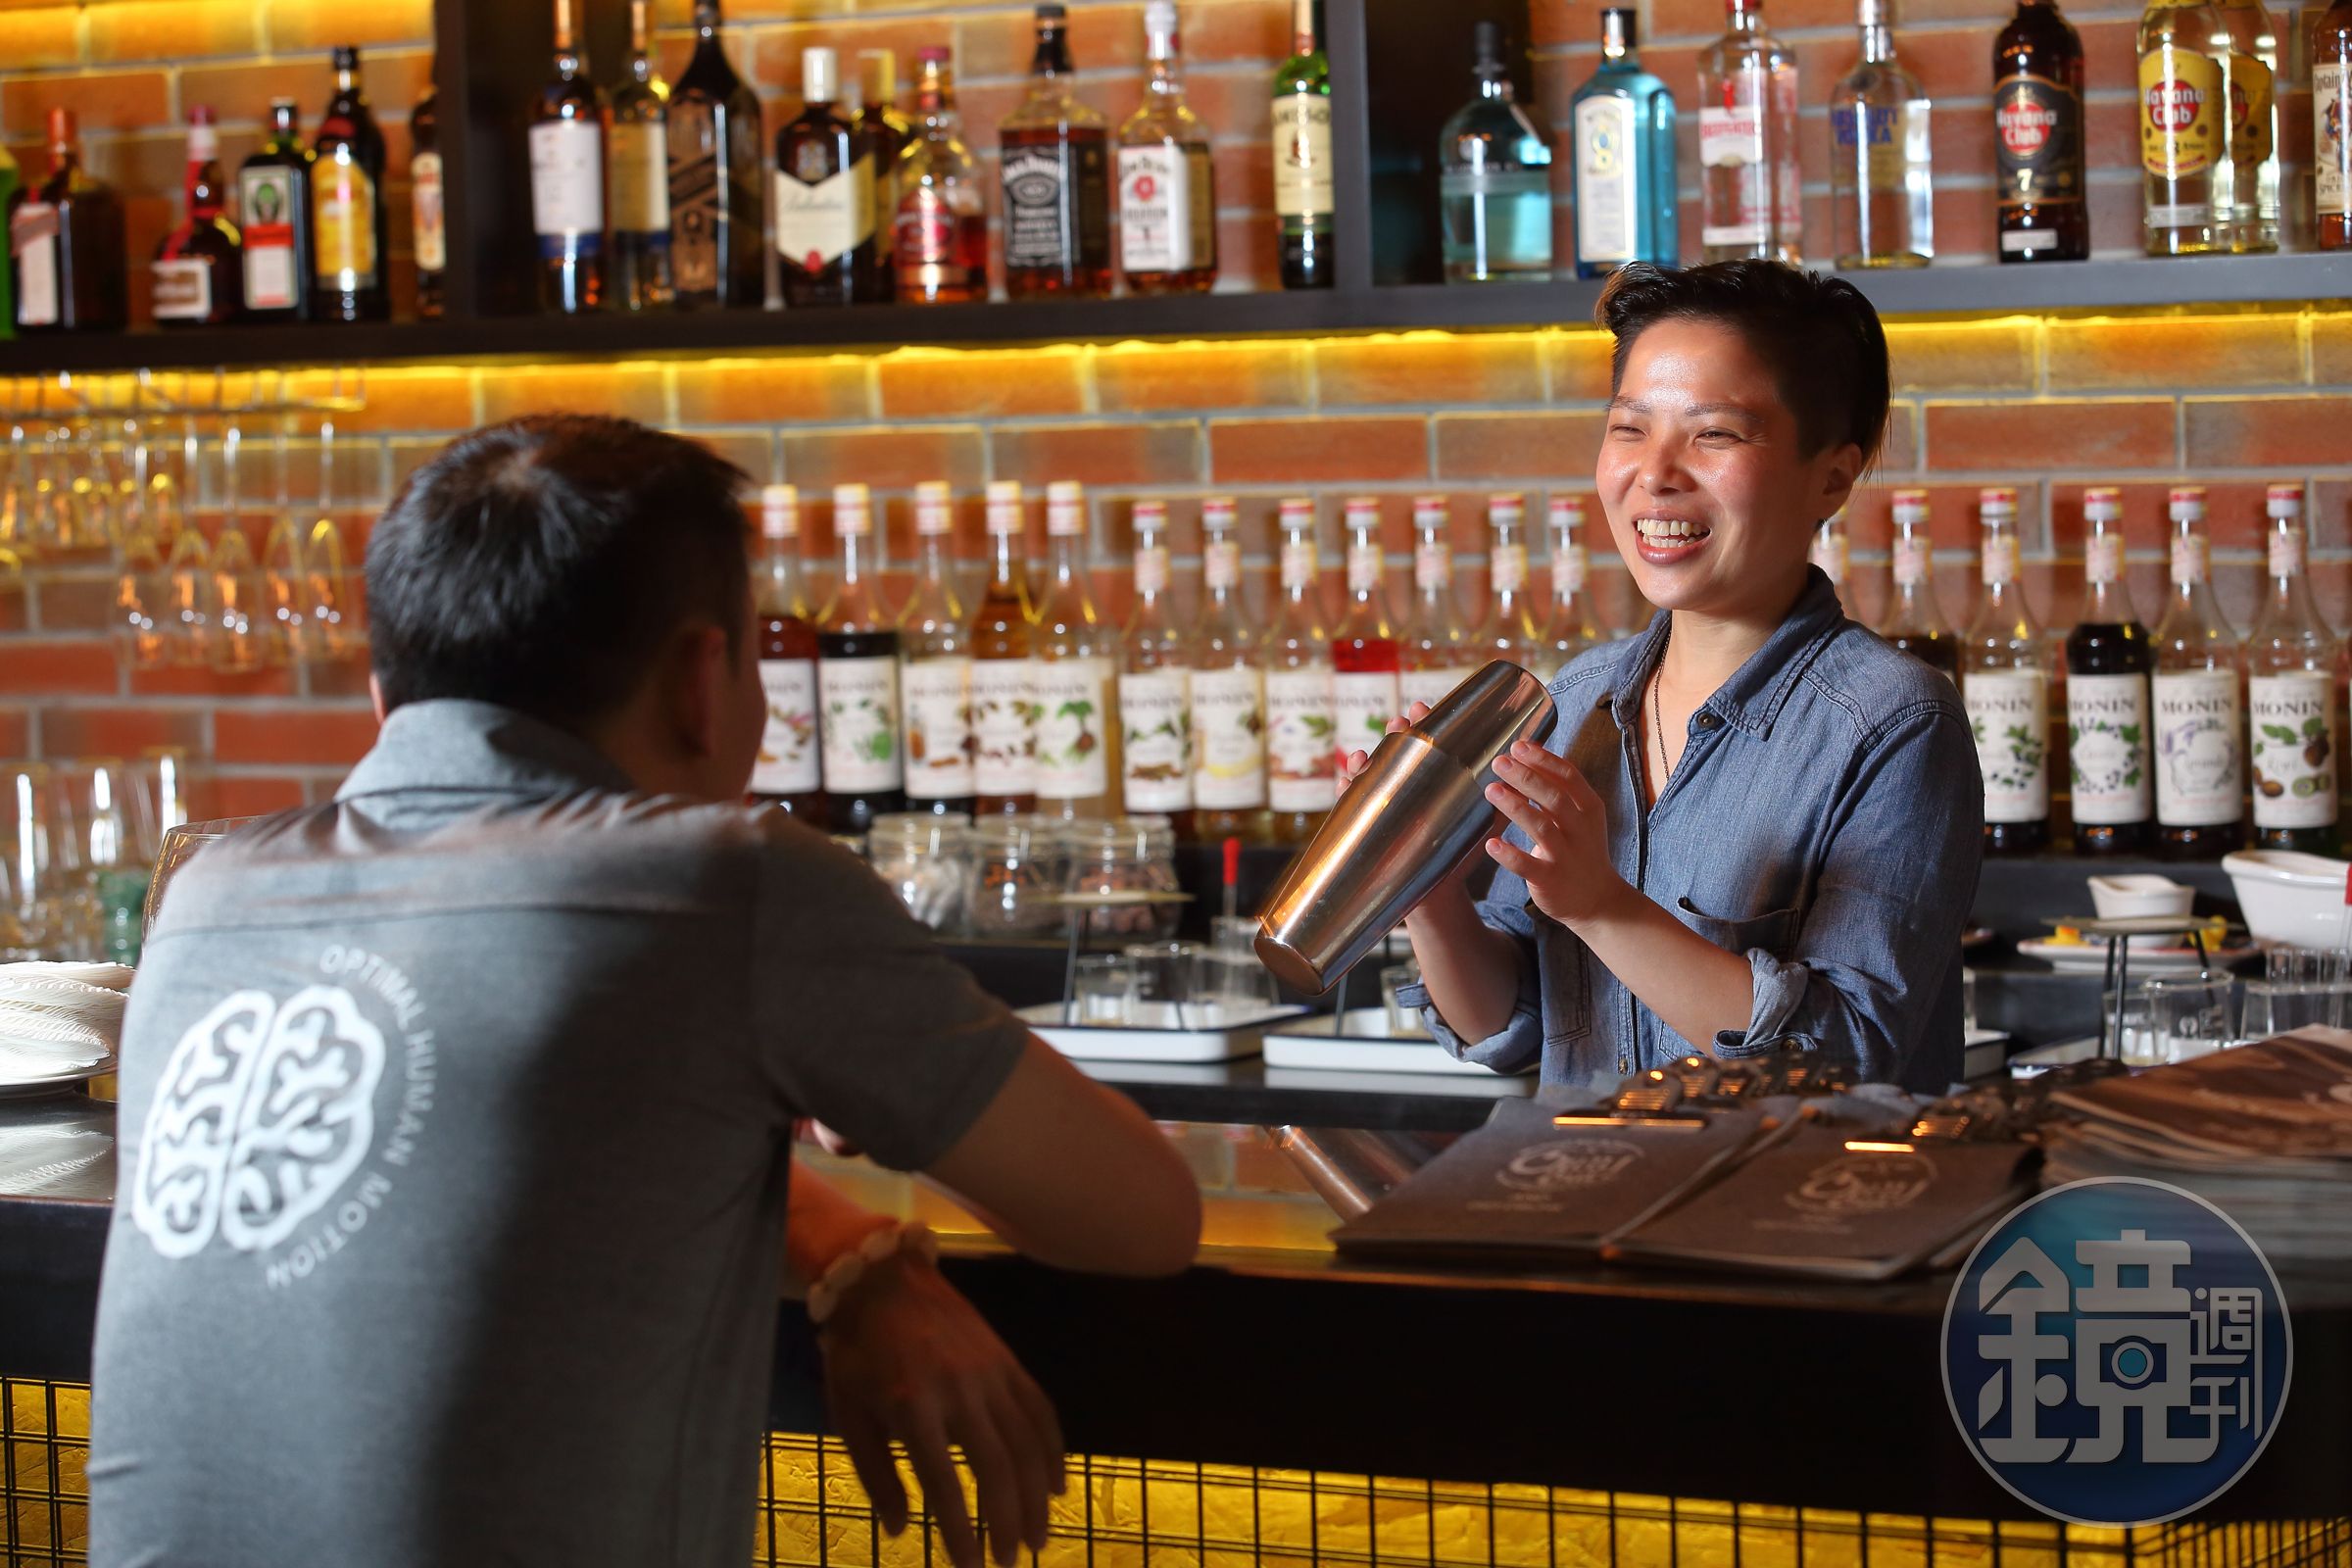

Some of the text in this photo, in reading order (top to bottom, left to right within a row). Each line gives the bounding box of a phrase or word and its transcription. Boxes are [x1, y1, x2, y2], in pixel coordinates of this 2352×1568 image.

[2145, 87, 2205, 105] Haana
[1996, 109, 2057, 127] Havana
[2152, 105, 2192, 125] Clb
[2004, 124, 2043, 146] Club
[2016, 168, 2034, 191] 7
[2160, 696, 2232, 715] MONIN
[2254, 699, 2324, 716] MONIN
[266, 943, 438, 1292] OPTIMAL HUMAN MOTION
